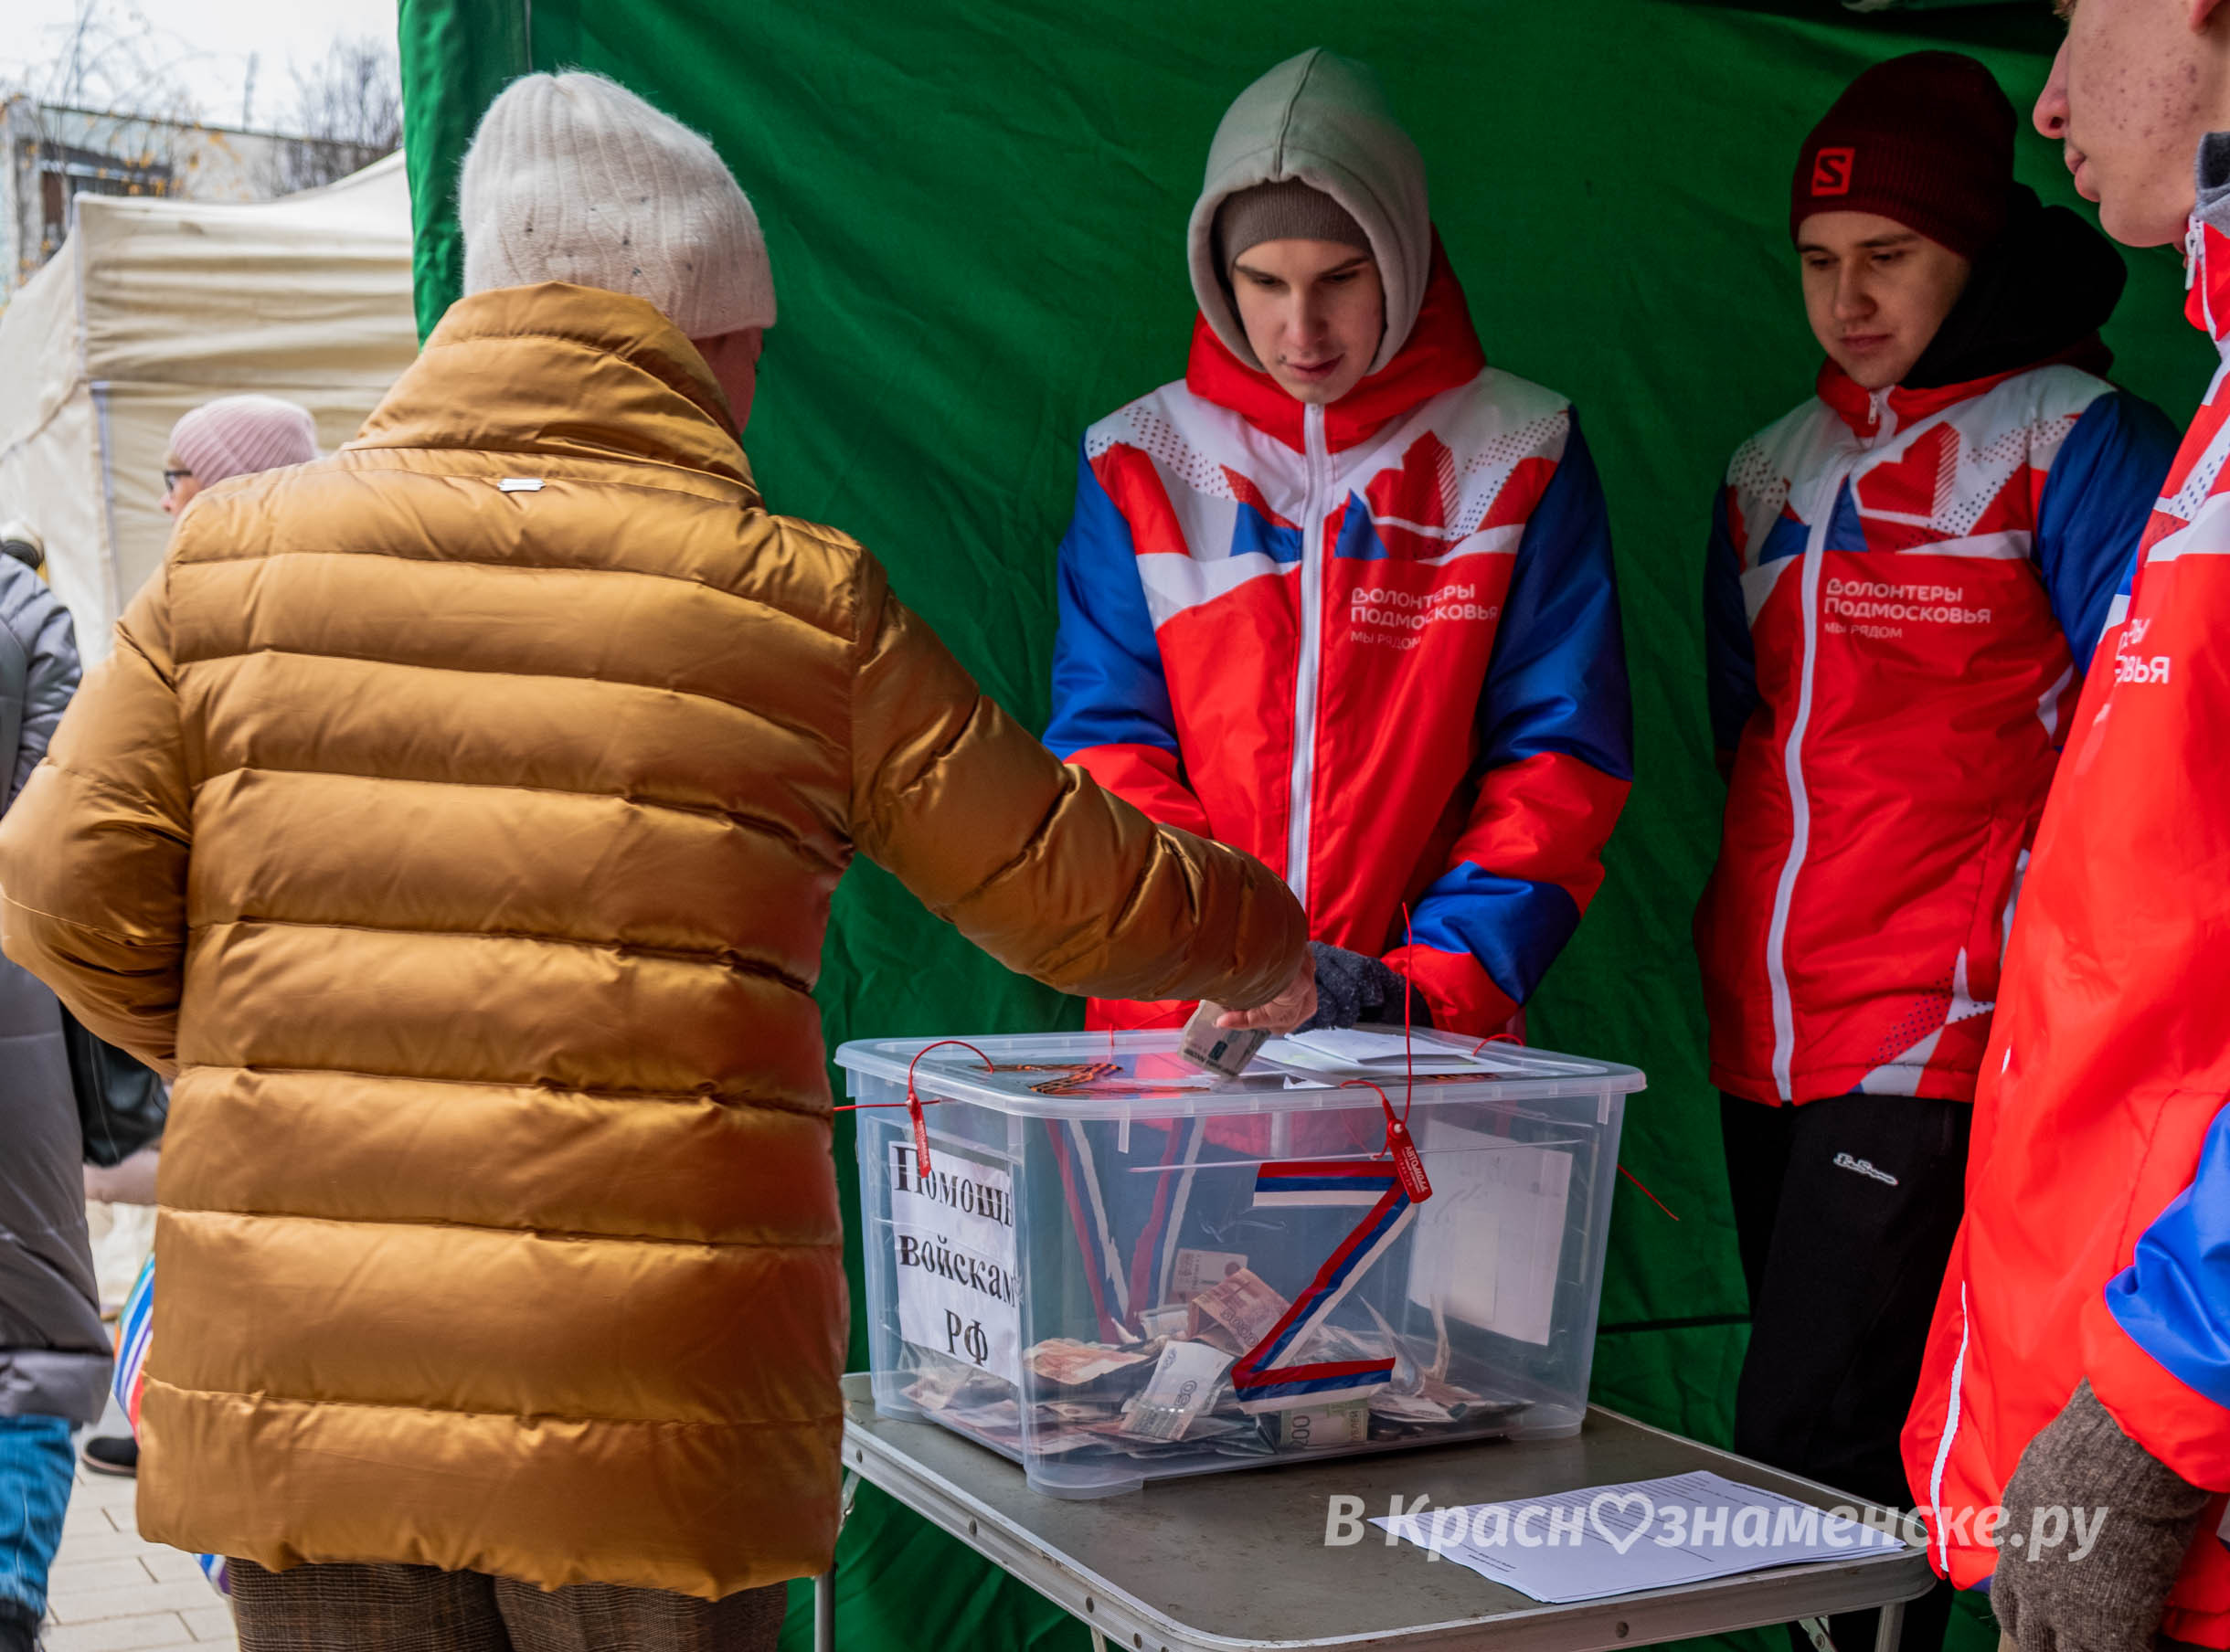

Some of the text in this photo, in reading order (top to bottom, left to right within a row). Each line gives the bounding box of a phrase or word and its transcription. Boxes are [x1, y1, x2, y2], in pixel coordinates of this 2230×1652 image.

[1351, 583, 1476, 609] ВОЛОНТЕРЫ
[1826, 577, 1963, 602] ВОЛОНТЕРЫ
[1350, 603, 1499, 630] ПОДМОСКОВЬЯ
[1824, 597, 1991, 624] ПОДМОСКОВЬЯ
[944, 1308, 989, 1367] РФ
